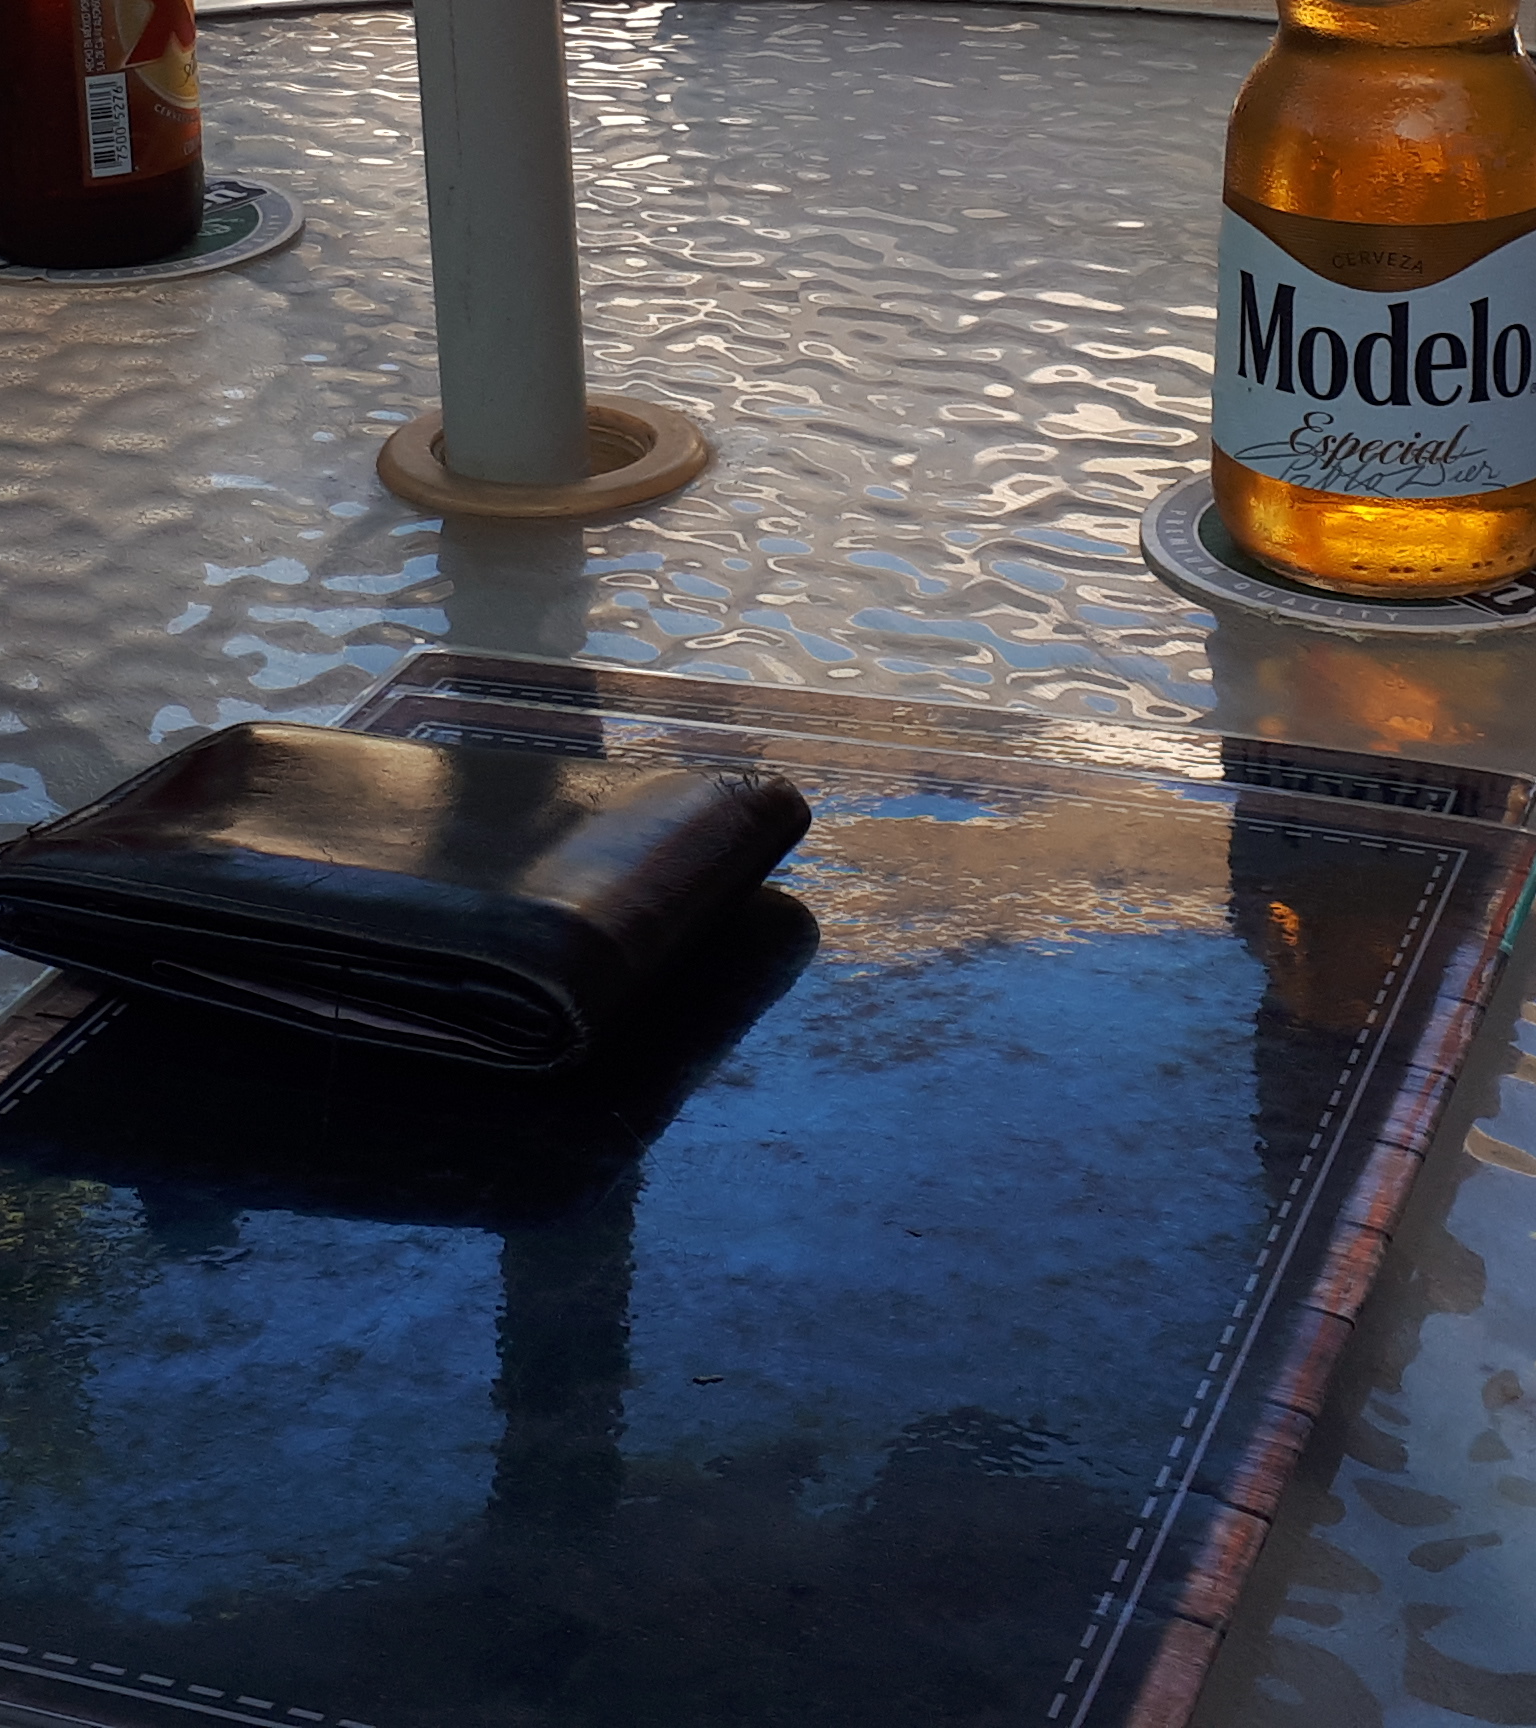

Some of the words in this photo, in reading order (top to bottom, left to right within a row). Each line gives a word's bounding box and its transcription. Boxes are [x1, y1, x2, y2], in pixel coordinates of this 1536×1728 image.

[112, 86, 125, 120] 5276
[114, 126, 128, 161] 7500
[1332, 251, 1423, 275] CERVEZA
[1238, 269, 1532, 407] Modelo
[1289, 411, 1470, 470] Especial
[1164, 508, 1219, 577] PREMIUM
[1232, 581, 1399, 622] QUALITY
